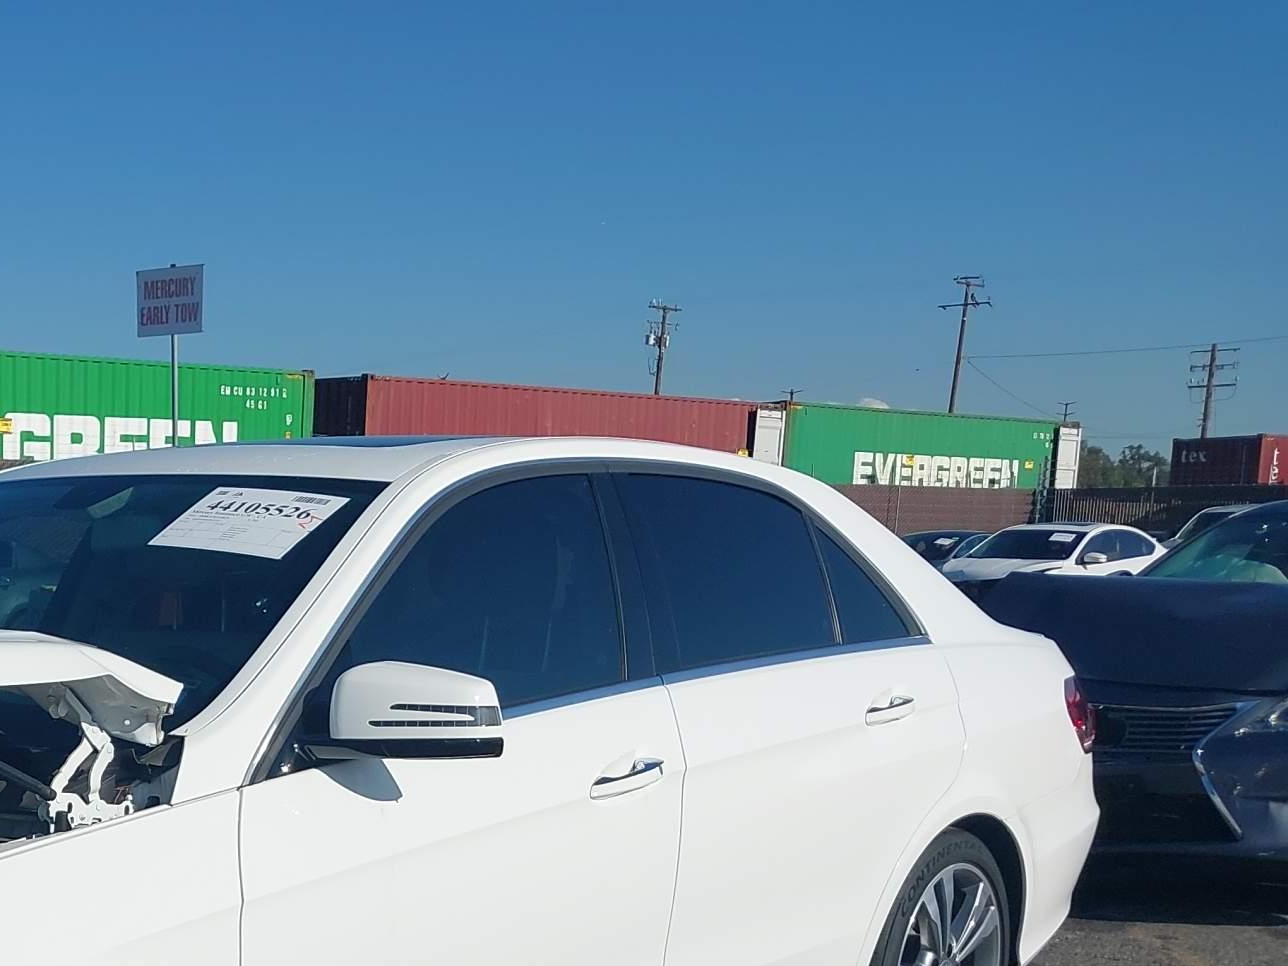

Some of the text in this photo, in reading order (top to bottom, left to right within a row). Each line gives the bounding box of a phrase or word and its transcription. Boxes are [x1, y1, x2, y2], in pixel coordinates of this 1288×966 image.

[143, 276, 196, 300] MERCURY
[140, 302, 199, 326] EARLY TOW
[852, 451, 1020, 489] EVERGREEN
[206, 499, 317, 520] 44105526
